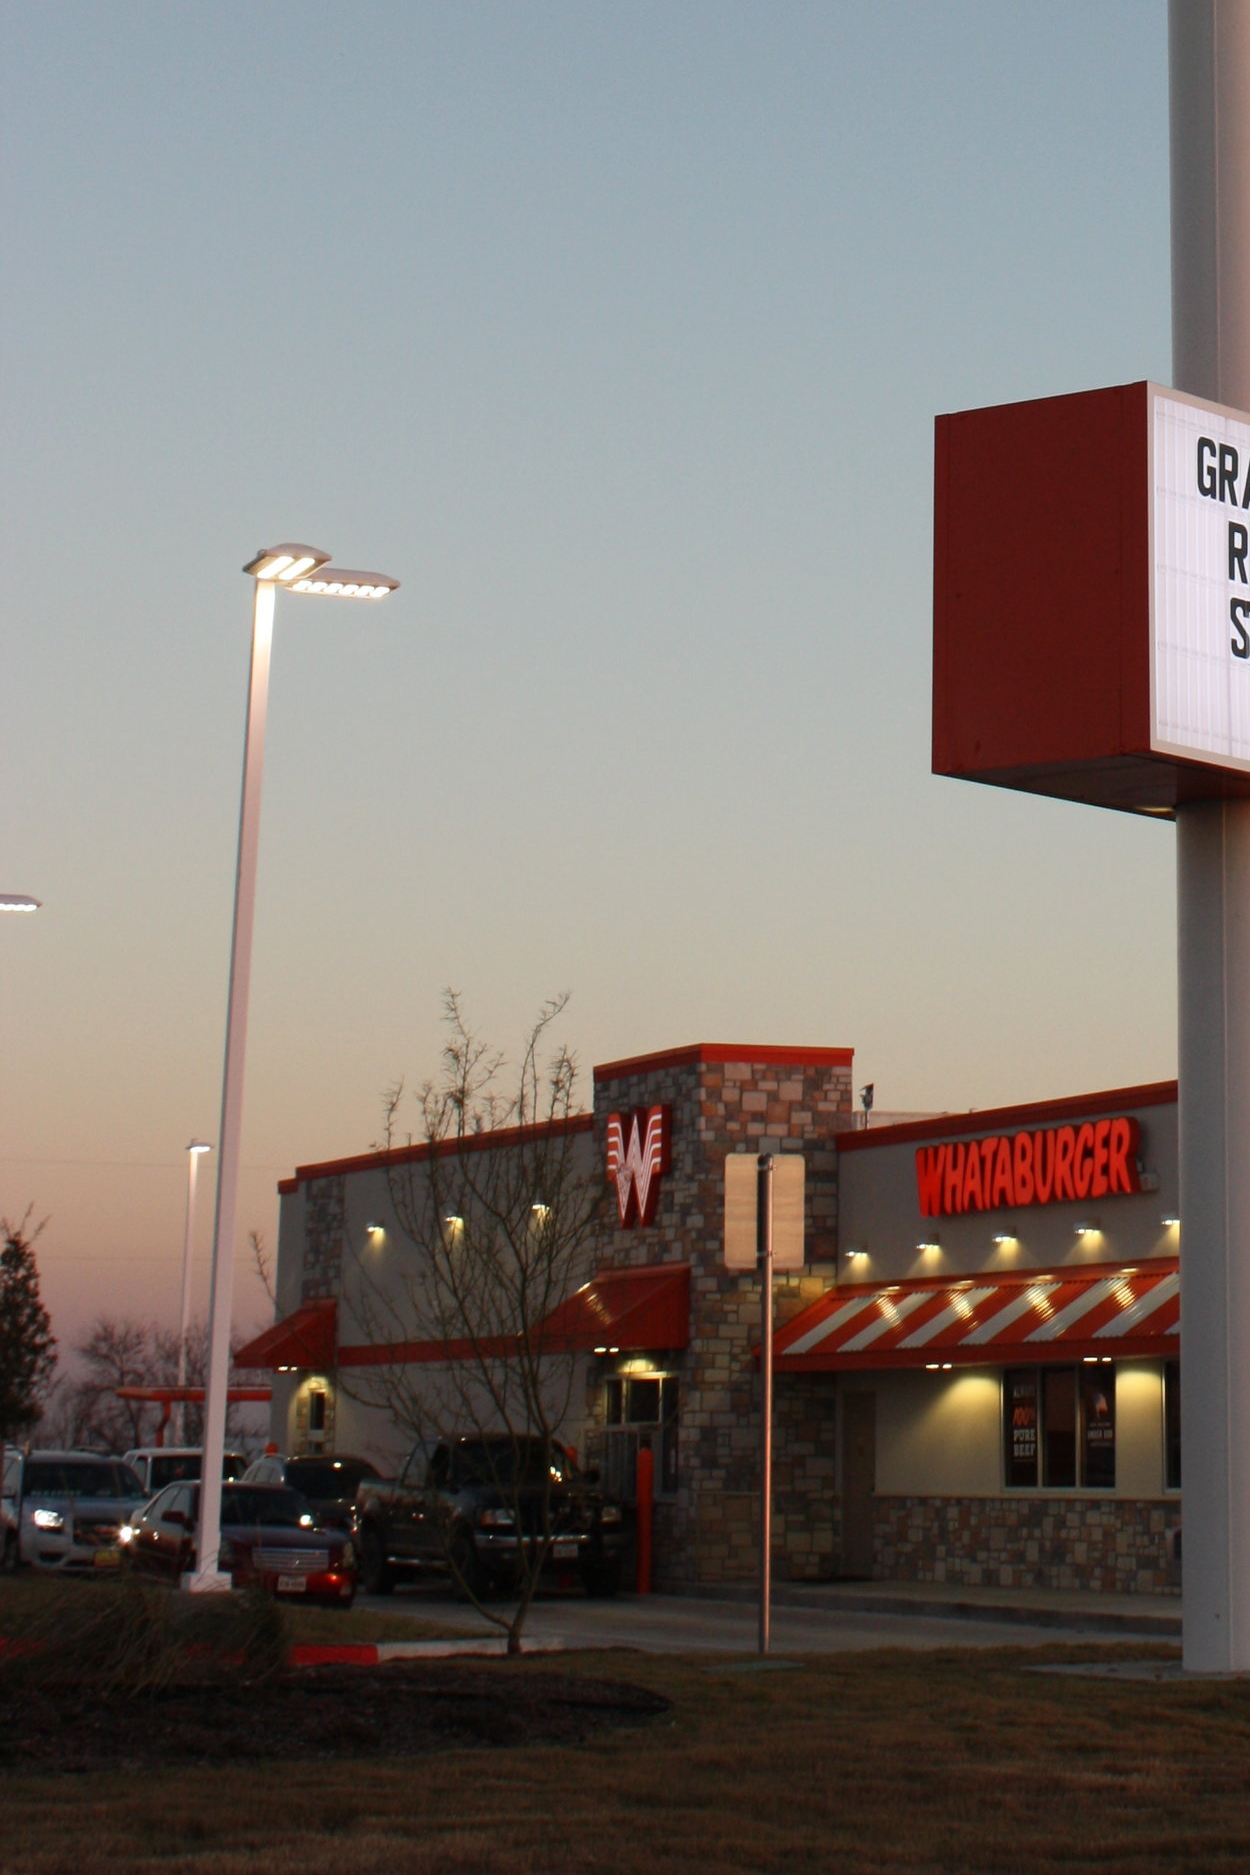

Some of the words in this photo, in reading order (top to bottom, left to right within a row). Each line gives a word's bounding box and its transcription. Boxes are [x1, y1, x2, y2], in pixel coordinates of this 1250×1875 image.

[915, 1116, 1134, 1218] WHATABURGER
[1013, 1429, 1036, 1442] PURE
[1013, 1443, 1036, 1457] BEEF
